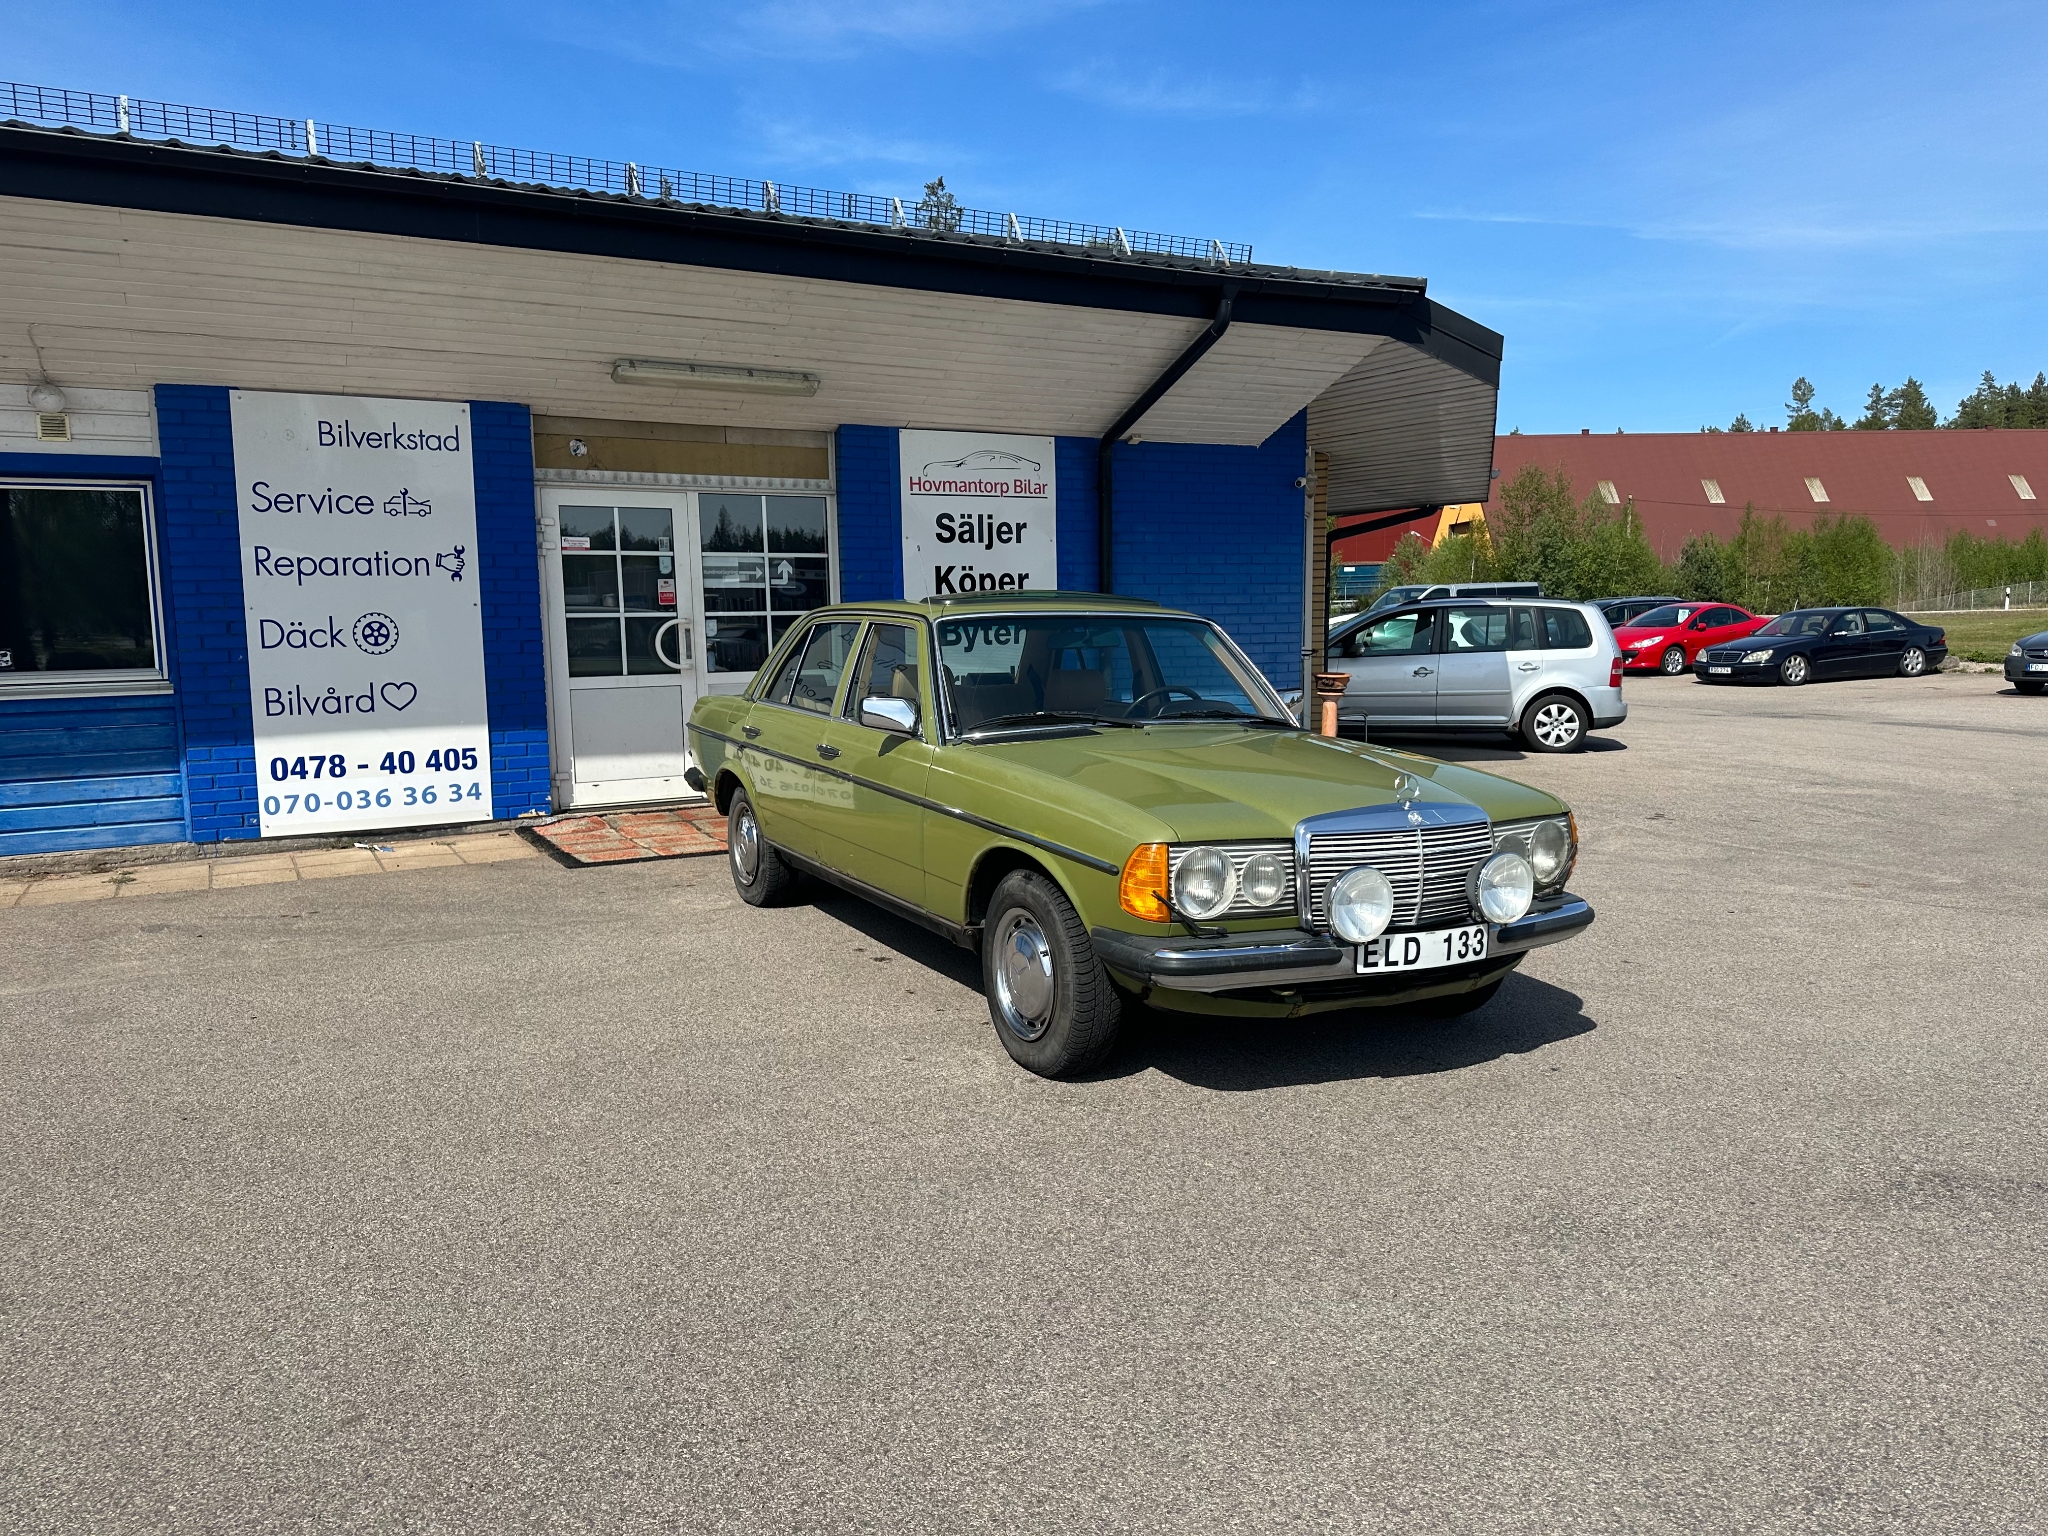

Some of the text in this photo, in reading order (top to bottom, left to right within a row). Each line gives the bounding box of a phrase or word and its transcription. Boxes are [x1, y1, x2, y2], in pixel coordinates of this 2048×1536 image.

[317, 420, 460, 452] Bilverkstad
[251, 481, 375, 515] Service
[909, 475, 1048, 497] Hovmantorp Bilar
[935, 512, 1027, 551] Säljer
[254, 545, 431, 586] Reparation
[259, 616, 348, 650] Däck
[264, 682, 375, 717] Bilvård
[270, 755, 347, 782] 0478
[379, 750, 416, 775] 40
[426, 747, 479, 773] 405
[263, 782, 483, 816] 070-036 36 34
[1362, 928, 1485, 968] ELD 133
